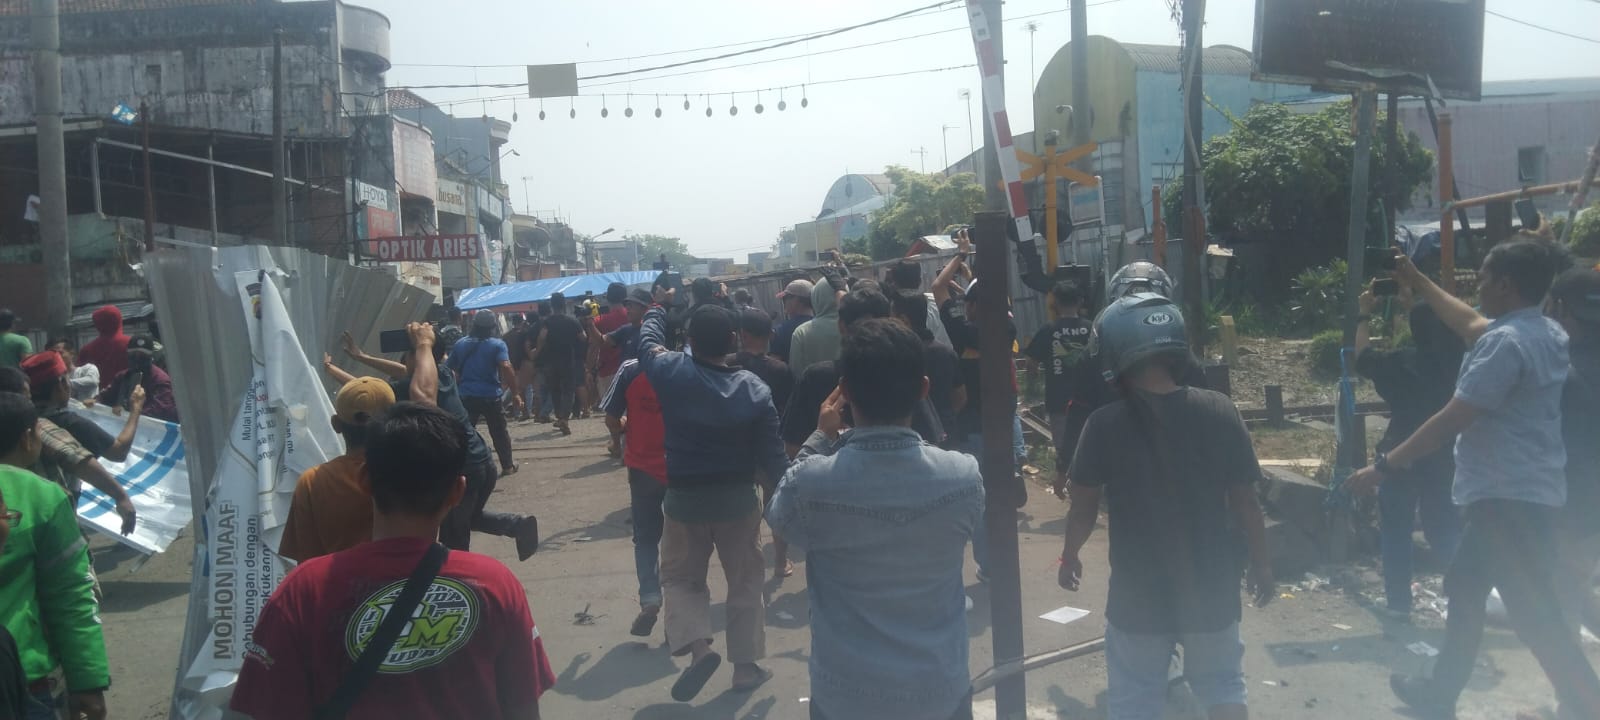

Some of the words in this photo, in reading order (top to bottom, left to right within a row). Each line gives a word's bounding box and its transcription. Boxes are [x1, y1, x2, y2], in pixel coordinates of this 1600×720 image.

[363, 186, 386, 202] HOYA
[379, 240, 426, 259] OPTIK
[432, 237, 477, 258] ARIES
[242, 416, 252, 441] Mulai
[215, 503, 236, 565] MAAF
[244, 517, 258, 568] dengan
[213, 572, 235, 660] MOHON
